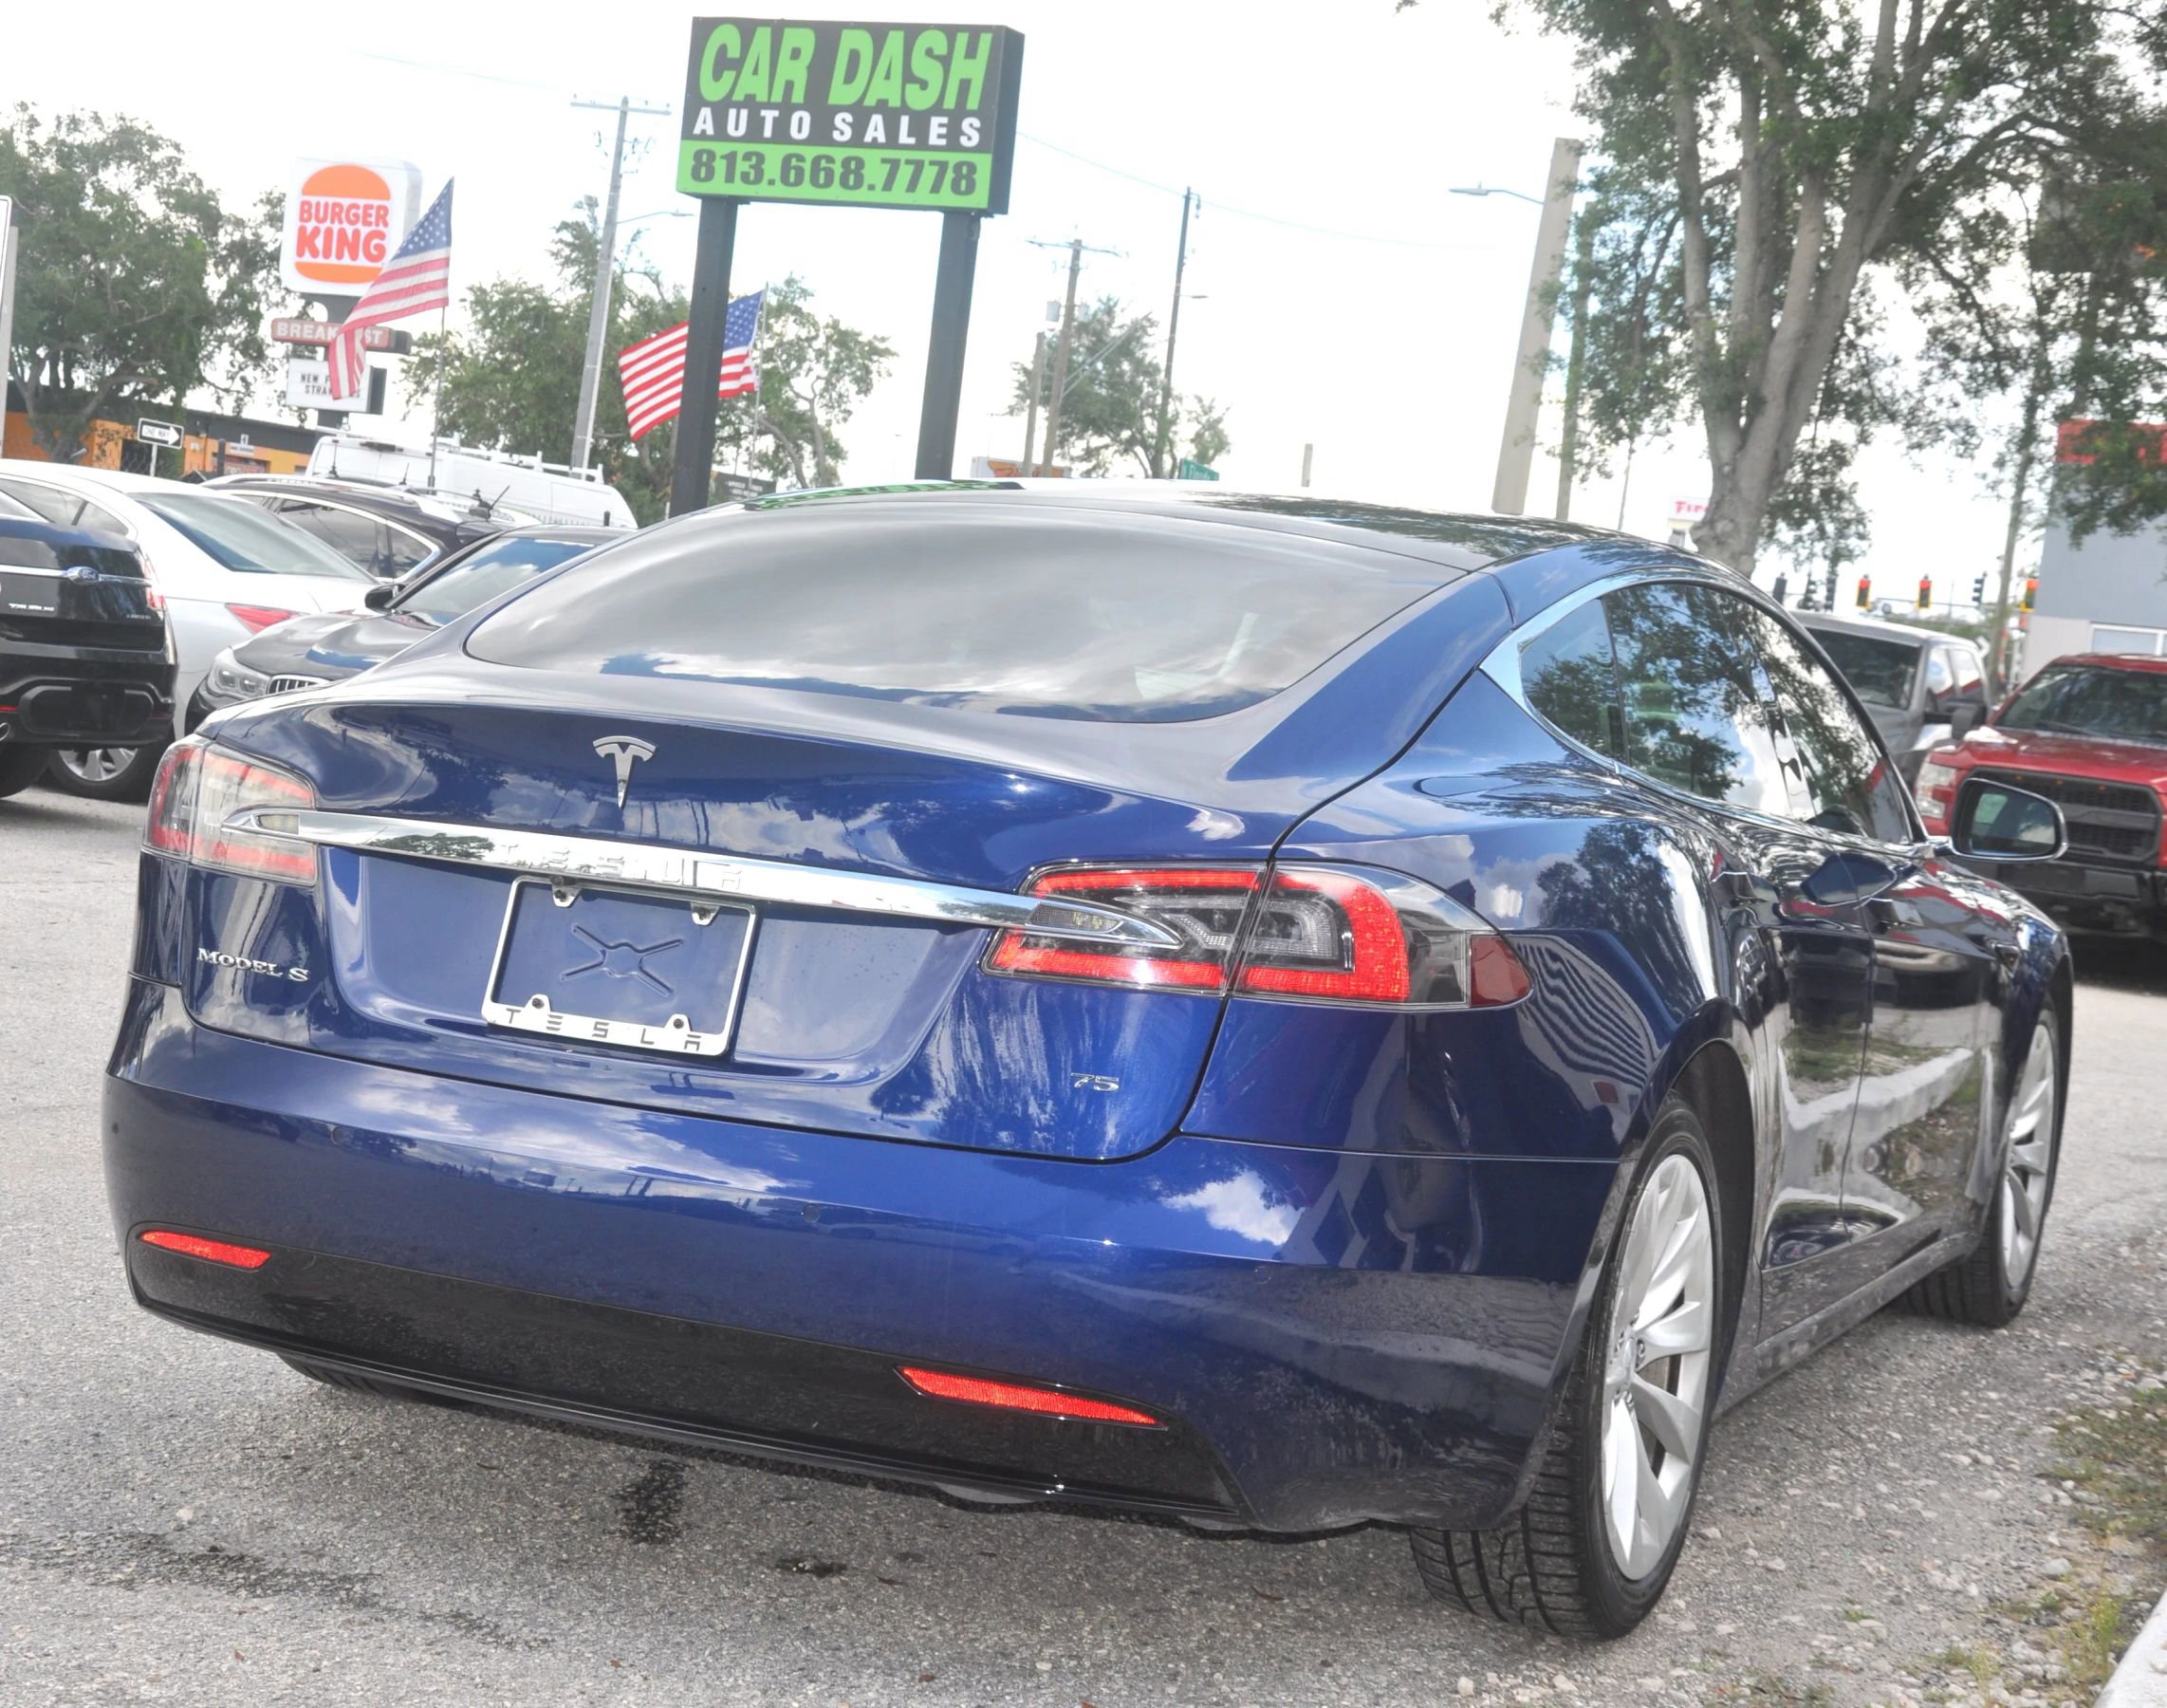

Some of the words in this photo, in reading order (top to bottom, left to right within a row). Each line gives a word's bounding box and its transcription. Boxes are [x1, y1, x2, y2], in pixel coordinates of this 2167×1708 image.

[698, 23, 816, 104] CAR
[827, 28, 993, 112] DASH
[693, 106, 812, 140] AUTO
[832, 111, 982, 148] SALES
[690, 148, 978, 197] 813.668.7778
[299, 199, 390, 229] BURGER
[295, 224, 387, 264] KING
[277, 321, 382, 344] BREAKST
[1676, 500, 1709, 514] Fir
[197, 947, 284, 978] MODEL
[288, 967, 309, 982] S
[505, 1008, 702, 1052] TESLA
[1070, 1072, 1120, 1092] 75
